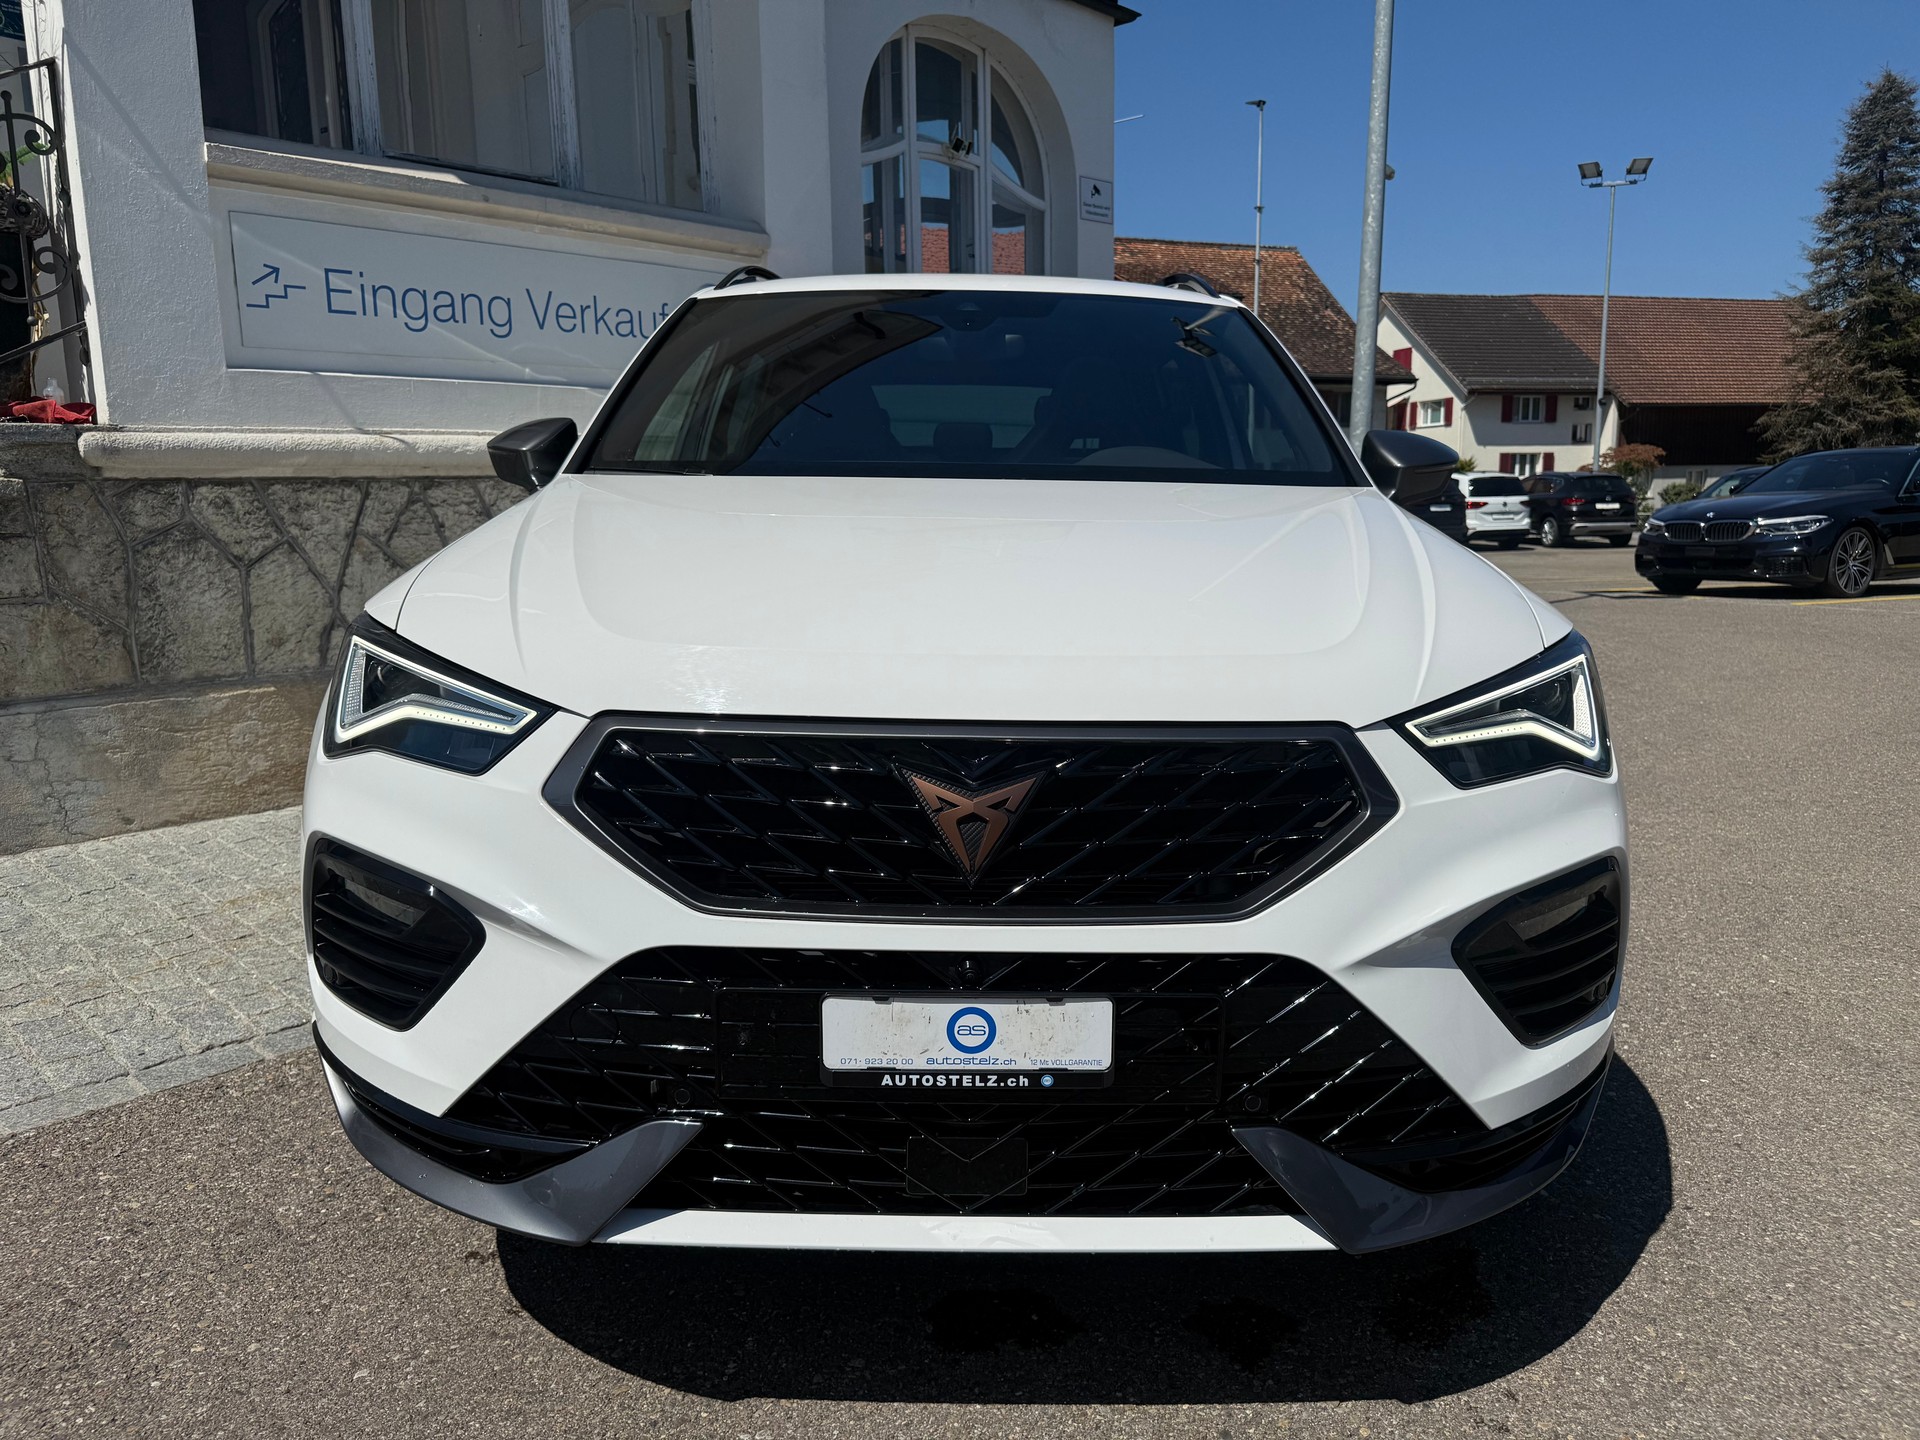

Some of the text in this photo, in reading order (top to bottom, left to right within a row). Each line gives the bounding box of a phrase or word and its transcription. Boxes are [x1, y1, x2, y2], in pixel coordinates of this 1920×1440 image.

[324, 267, 512, 339] Eingang
[957, 1025, 986, 1036] as
[864, 1057, 883, 1065] 923
[901, 1058, 914, 1066] 00
[926, 1055, 1017, 1066] autostelz.ch
[881, 1074, 1029, 1087] AUTOSTELZ.ch
